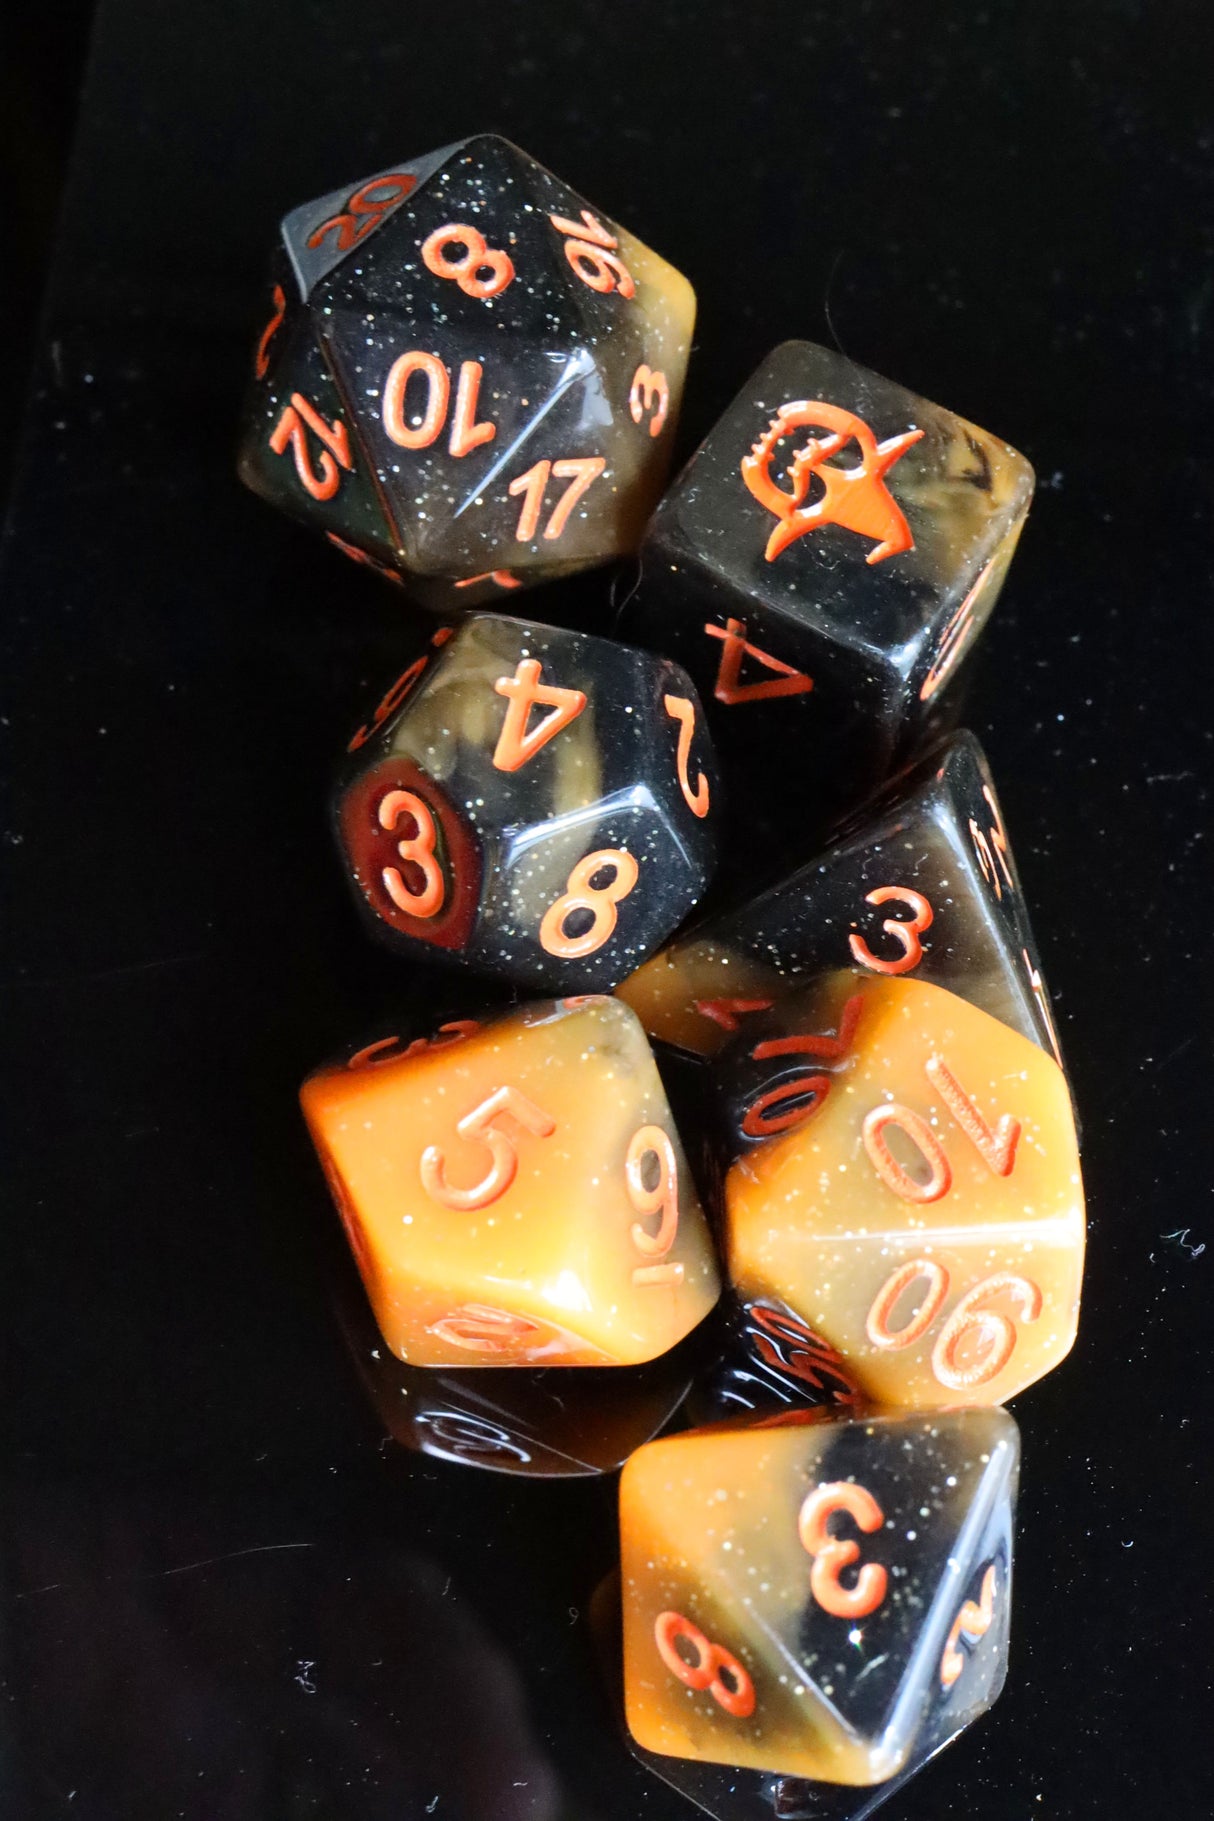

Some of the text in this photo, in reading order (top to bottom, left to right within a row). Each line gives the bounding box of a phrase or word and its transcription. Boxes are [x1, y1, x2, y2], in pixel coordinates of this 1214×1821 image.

[307, 173, 417, 251] 20
[421, 223, 515, 299] 8
[549, 210, 636, 300] 16
[269, 392, 352, 501] 12
[382, 351, 496, 458] 10
[630, 364, 669, 438] 3
[509, 457, 606, 541] 17
[705, 617, 814, 705] 4
[492, 658, 587, 772] 4
[378, 789, 444, 919] 3
[539, 848, 639, 959] 8
[848, 886, 933, 975] 3
[420, 1085, 556, 1212] 5
[862, 1052, 1022, 1203] 10
[799, 1482, 887, 1619] 3
[655, 1610, 755, 1718] 8
